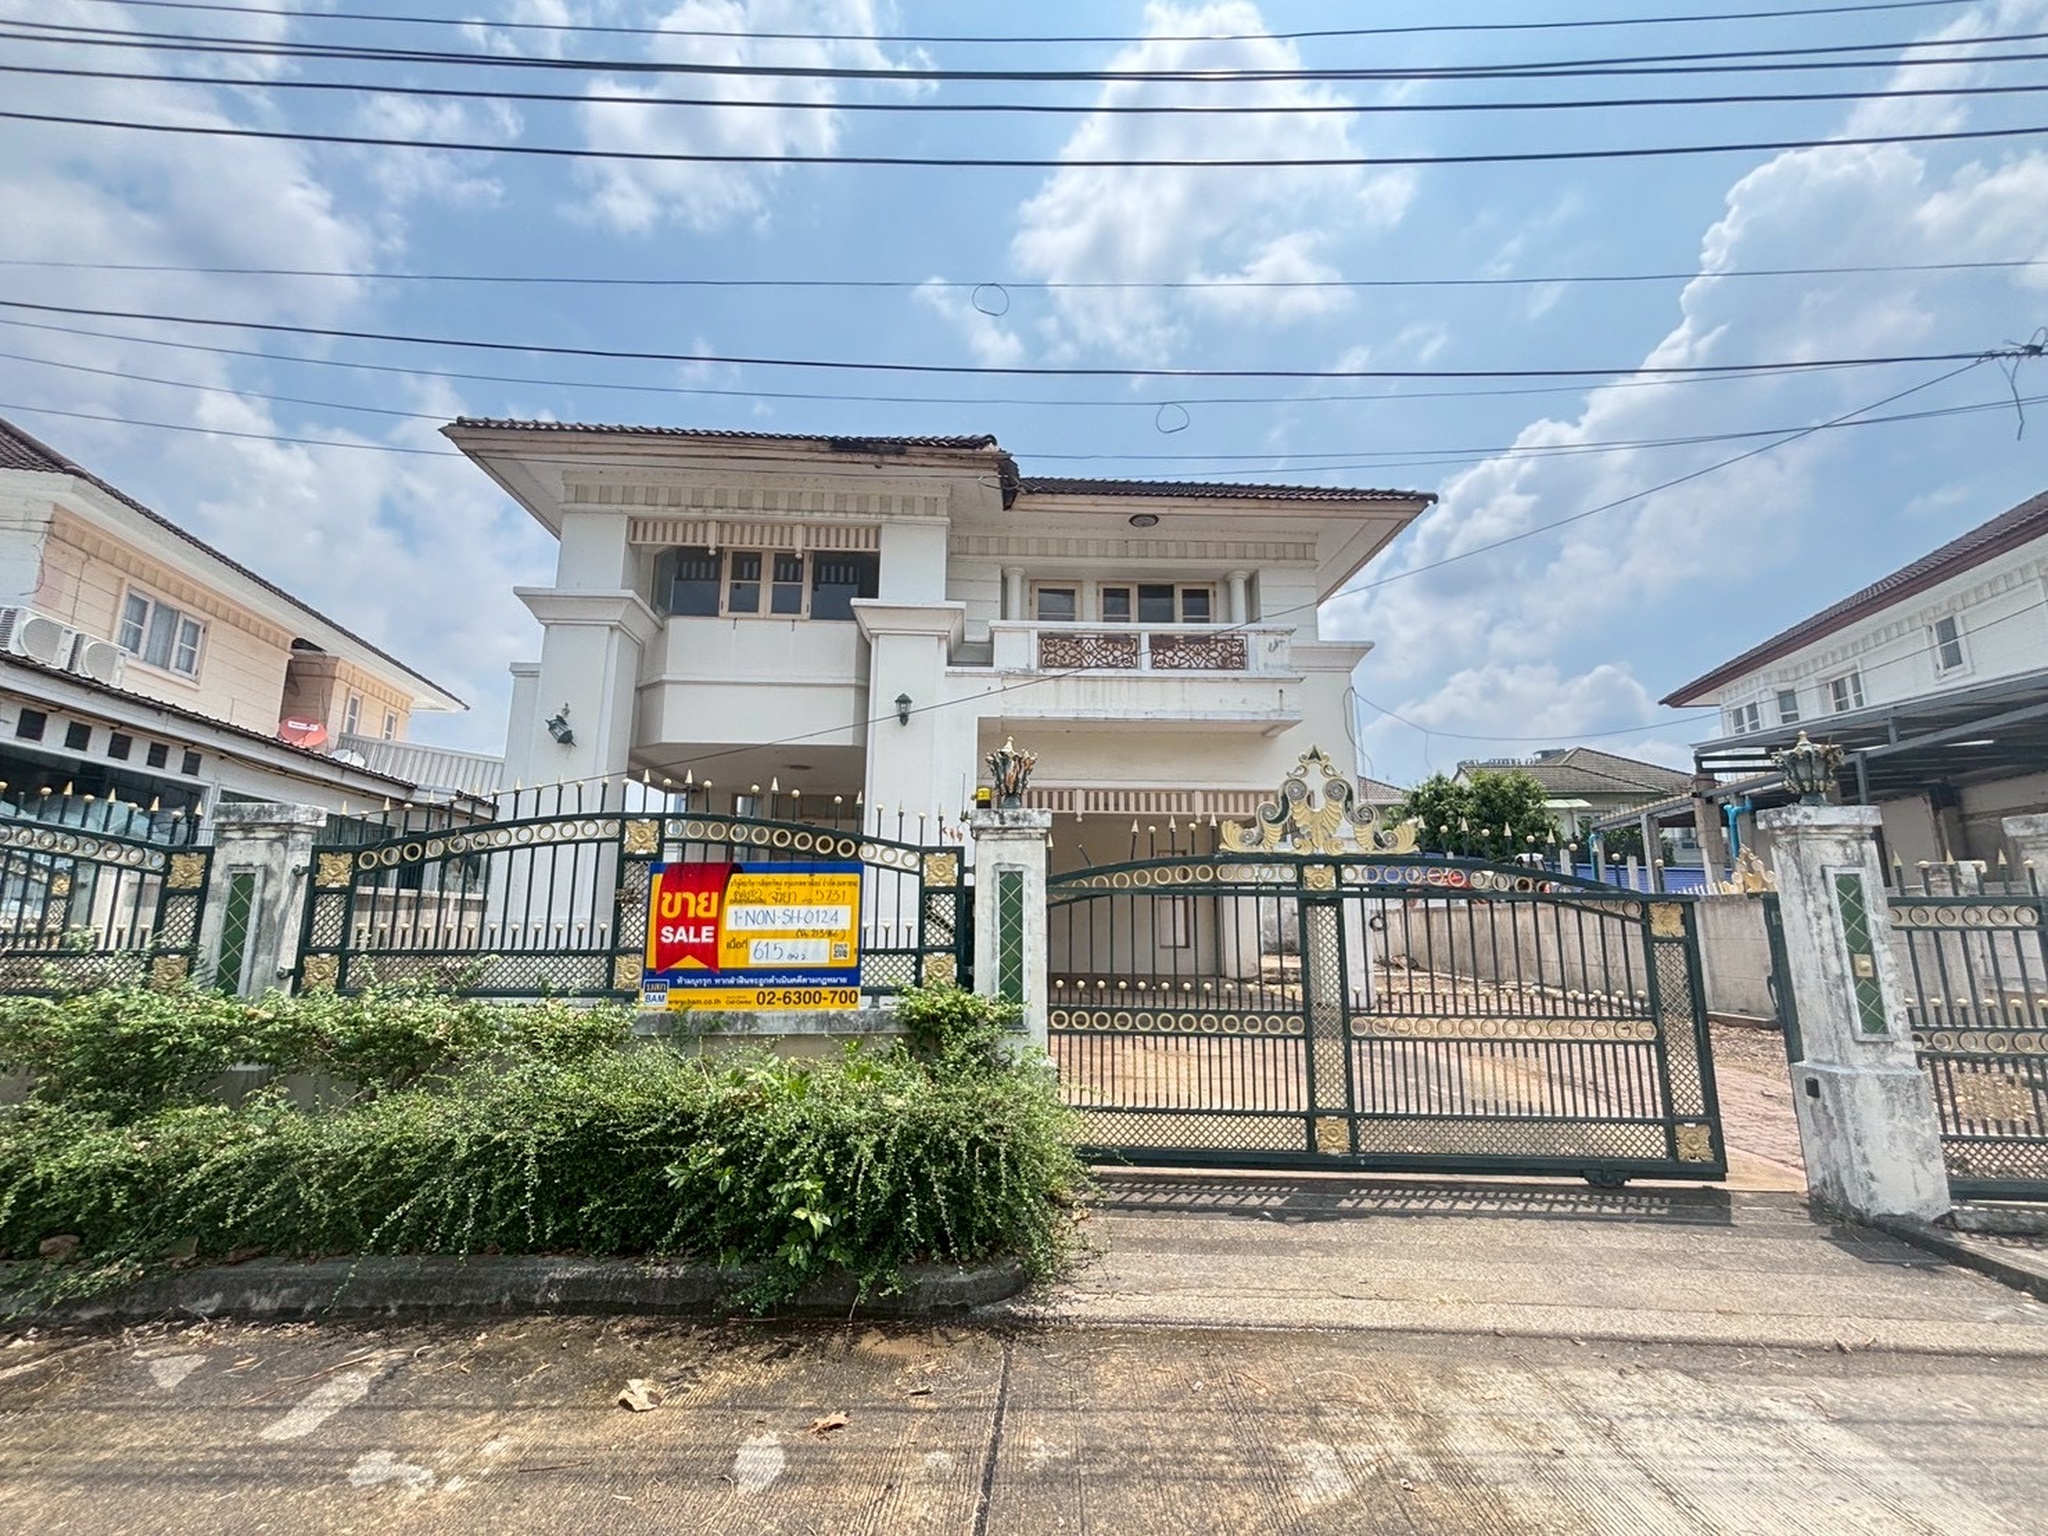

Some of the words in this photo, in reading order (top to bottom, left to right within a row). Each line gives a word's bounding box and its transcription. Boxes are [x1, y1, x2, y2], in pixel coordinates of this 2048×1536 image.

[661, 891, 719, 918] ขาย
[660, 925, 715, 943] SALE
[645, 994, 665, 1003] BAM
[756, 990, 858, 1005] 02-6300-700
